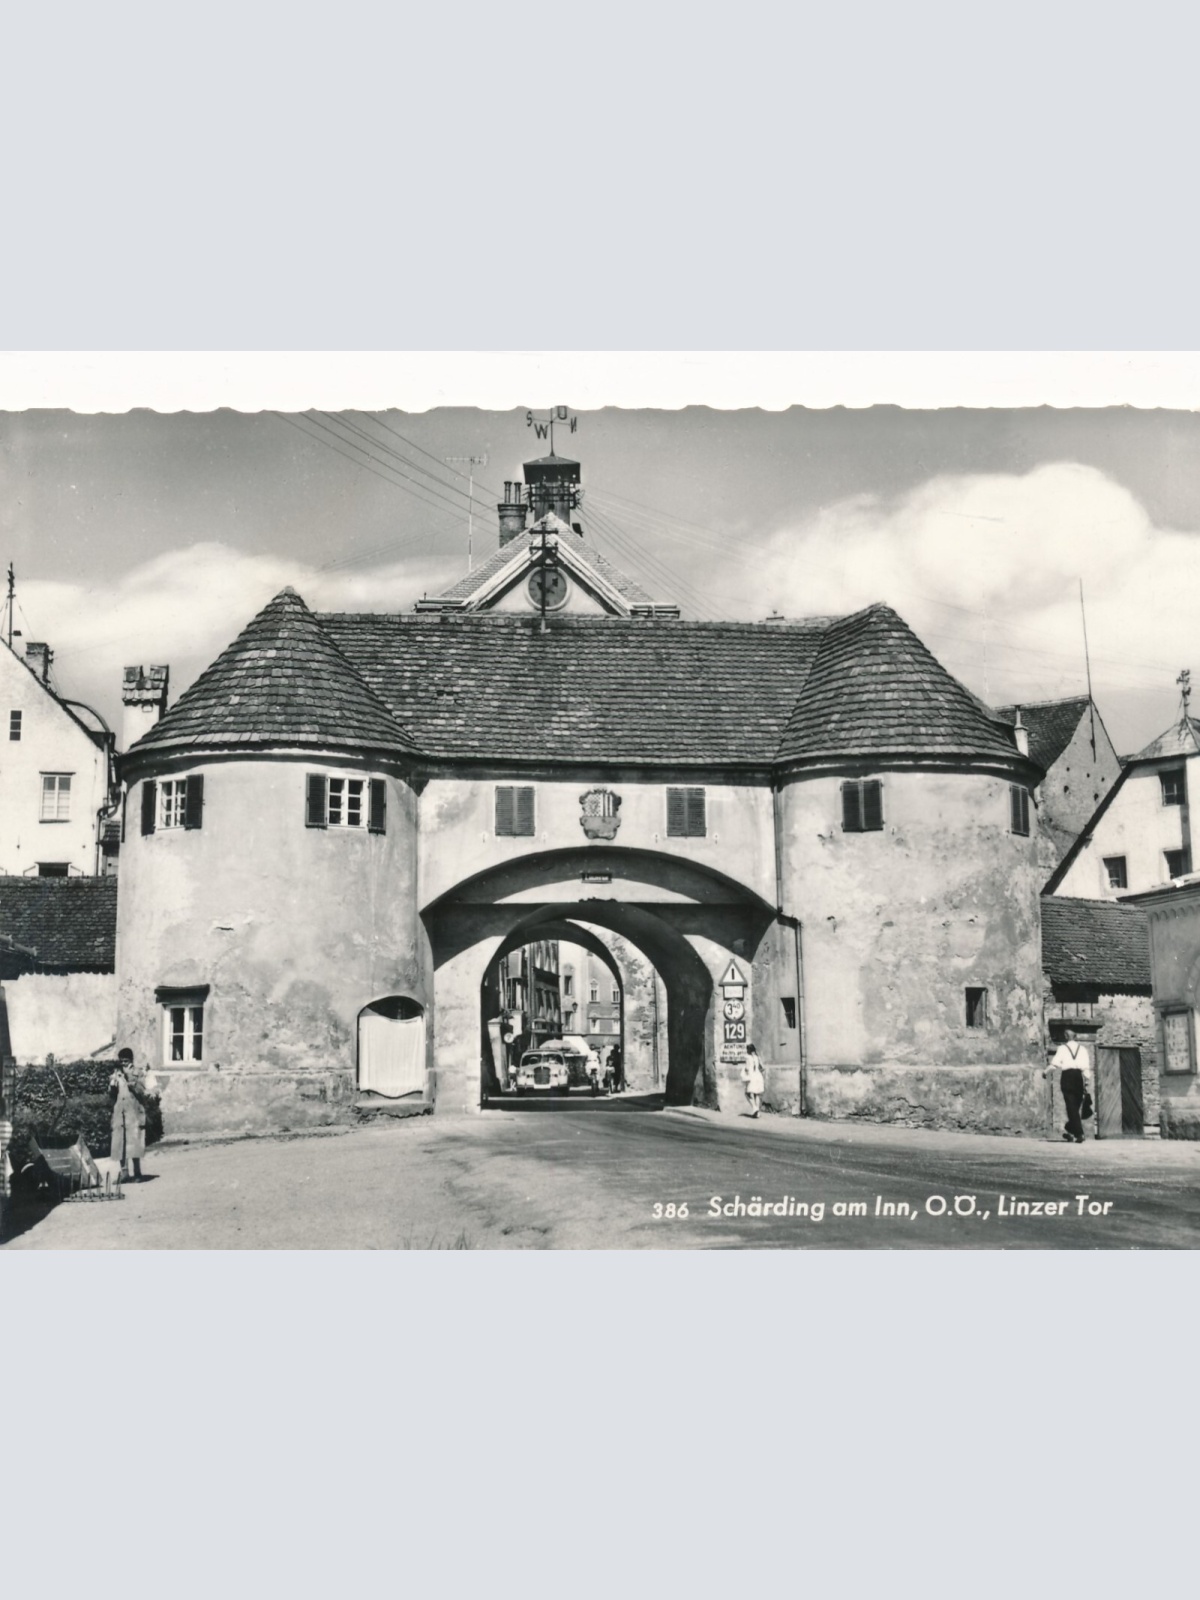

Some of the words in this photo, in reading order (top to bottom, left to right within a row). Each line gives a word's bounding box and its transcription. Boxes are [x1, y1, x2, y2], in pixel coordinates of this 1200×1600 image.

[526, 410, 533, 427] S
[534, 423, 549, 440] W
[725, 1023, 745, 1039] 129
